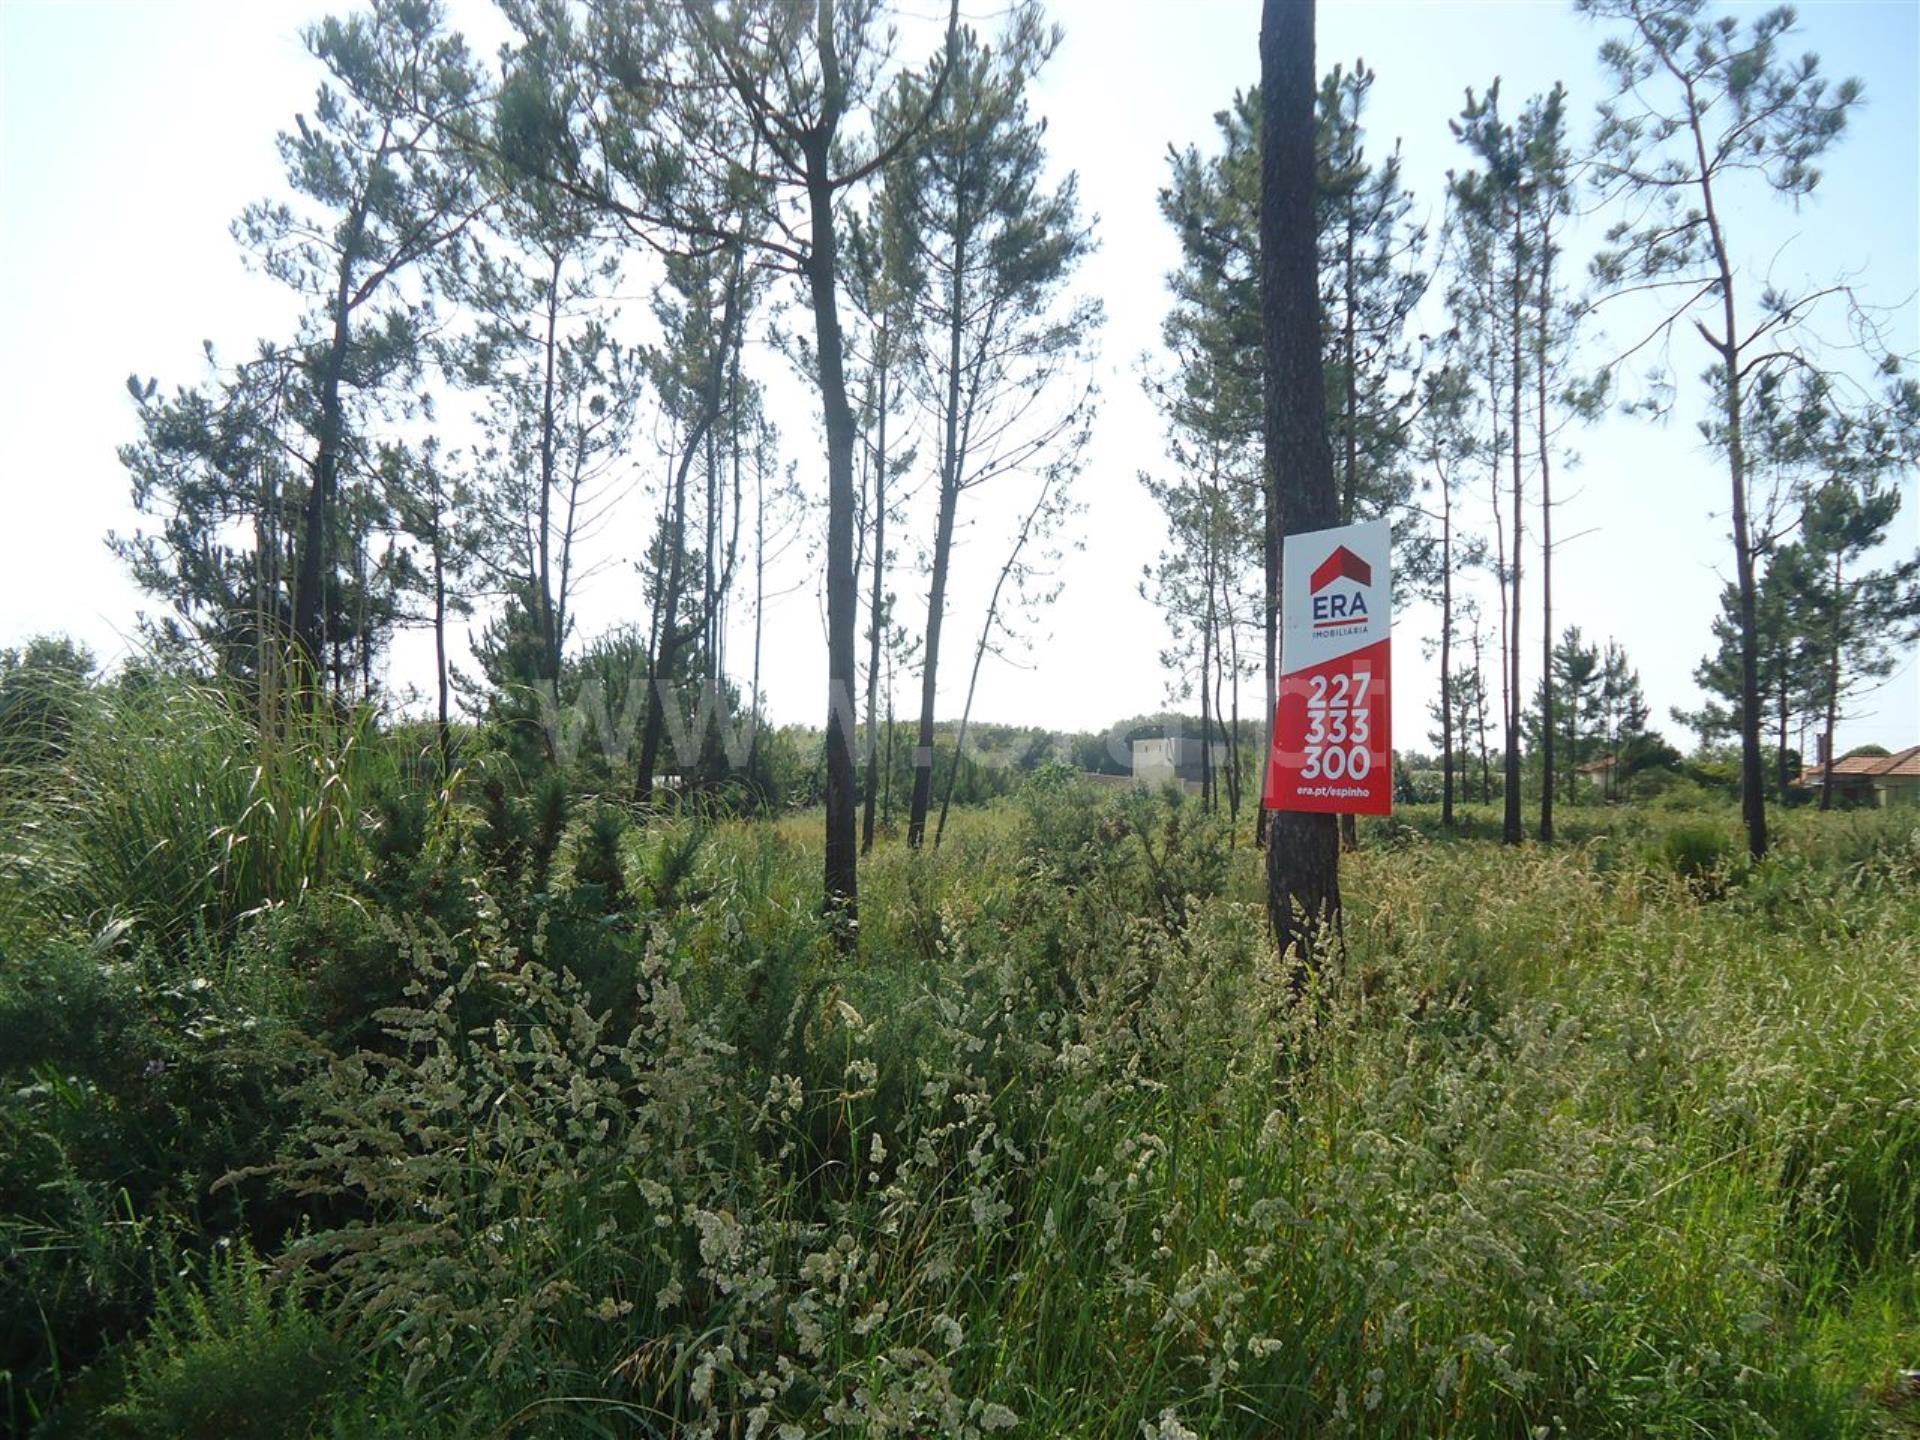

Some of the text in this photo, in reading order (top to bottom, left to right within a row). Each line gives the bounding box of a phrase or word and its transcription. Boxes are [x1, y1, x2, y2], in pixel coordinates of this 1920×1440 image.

[1313, 591, 1368, 620] ERA
[1308, 672, 1371, 708] 227
[1305, 709, 1369, 744] 333
[1301, 745, 1371, 780] 300
[1297, 785, 1370, 798] era.pt/espinho
